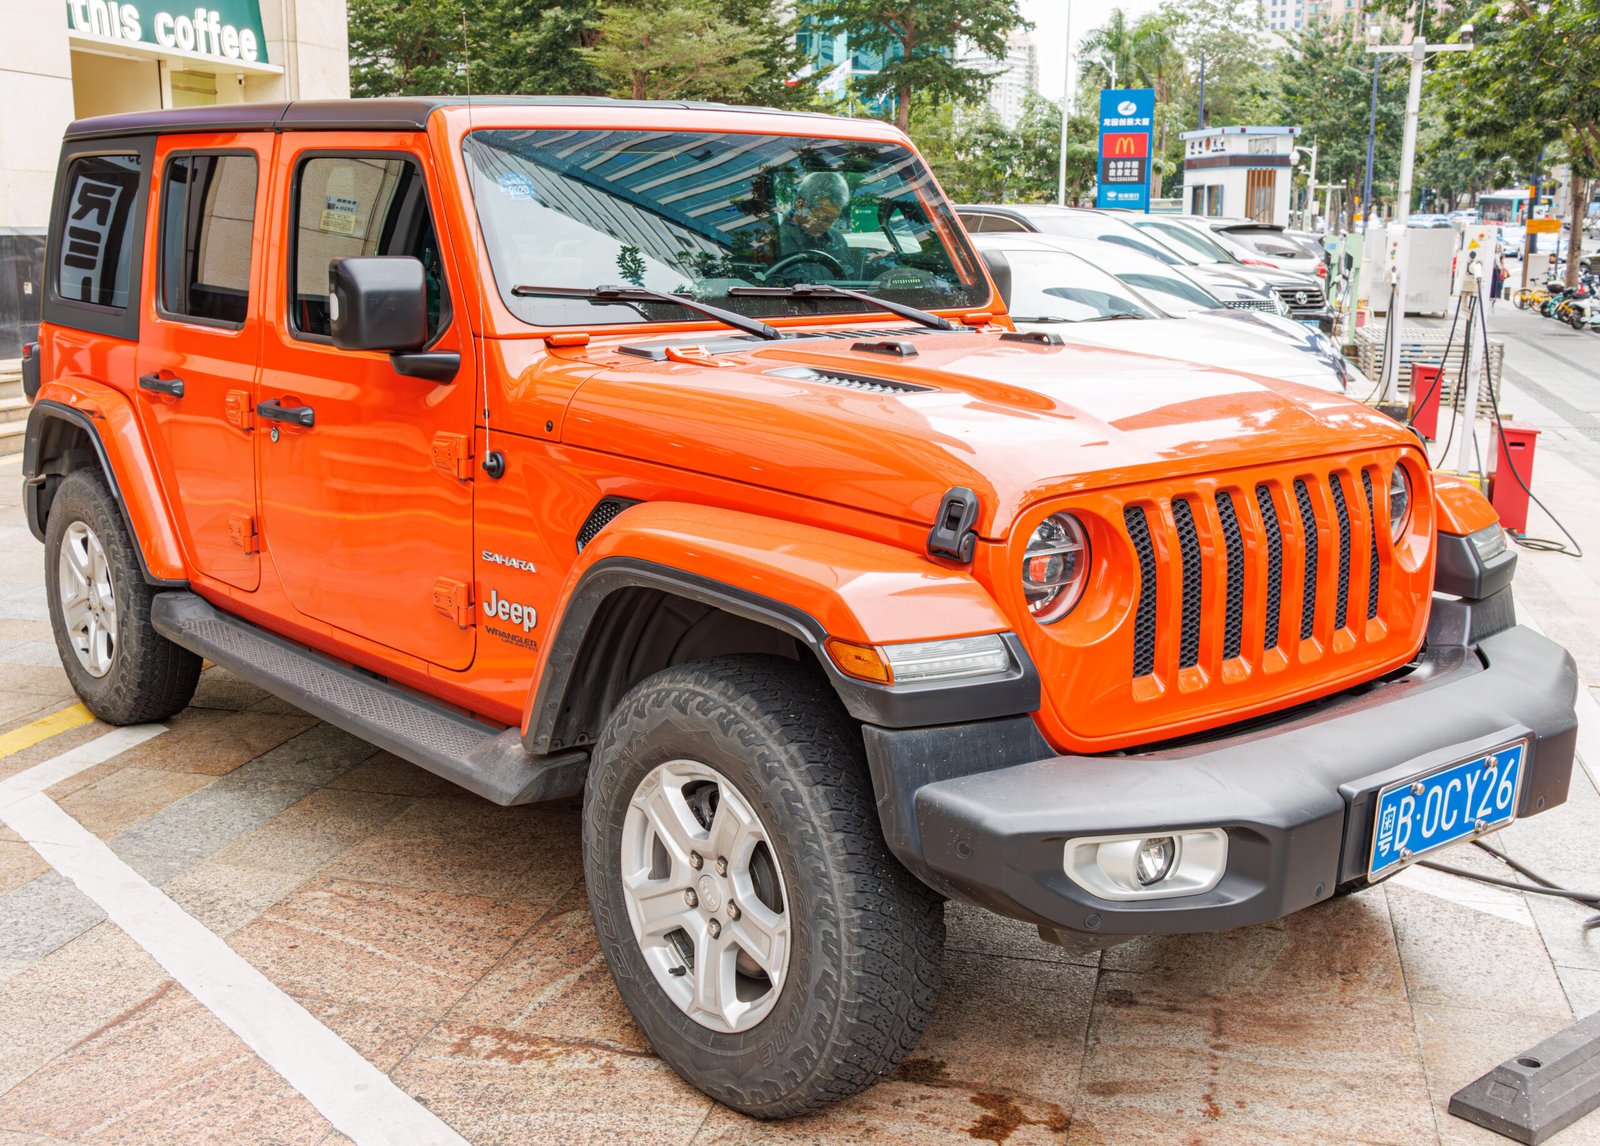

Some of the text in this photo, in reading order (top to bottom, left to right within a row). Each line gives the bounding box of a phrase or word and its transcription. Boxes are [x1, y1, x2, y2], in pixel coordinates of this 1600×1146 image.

[69, 0, 257, 62] this coffee
[482, 550, 536, 573] SAHARA
[483, 589, 537, 633] Jeep
[485, 625, 537, 648] WRANGLER
